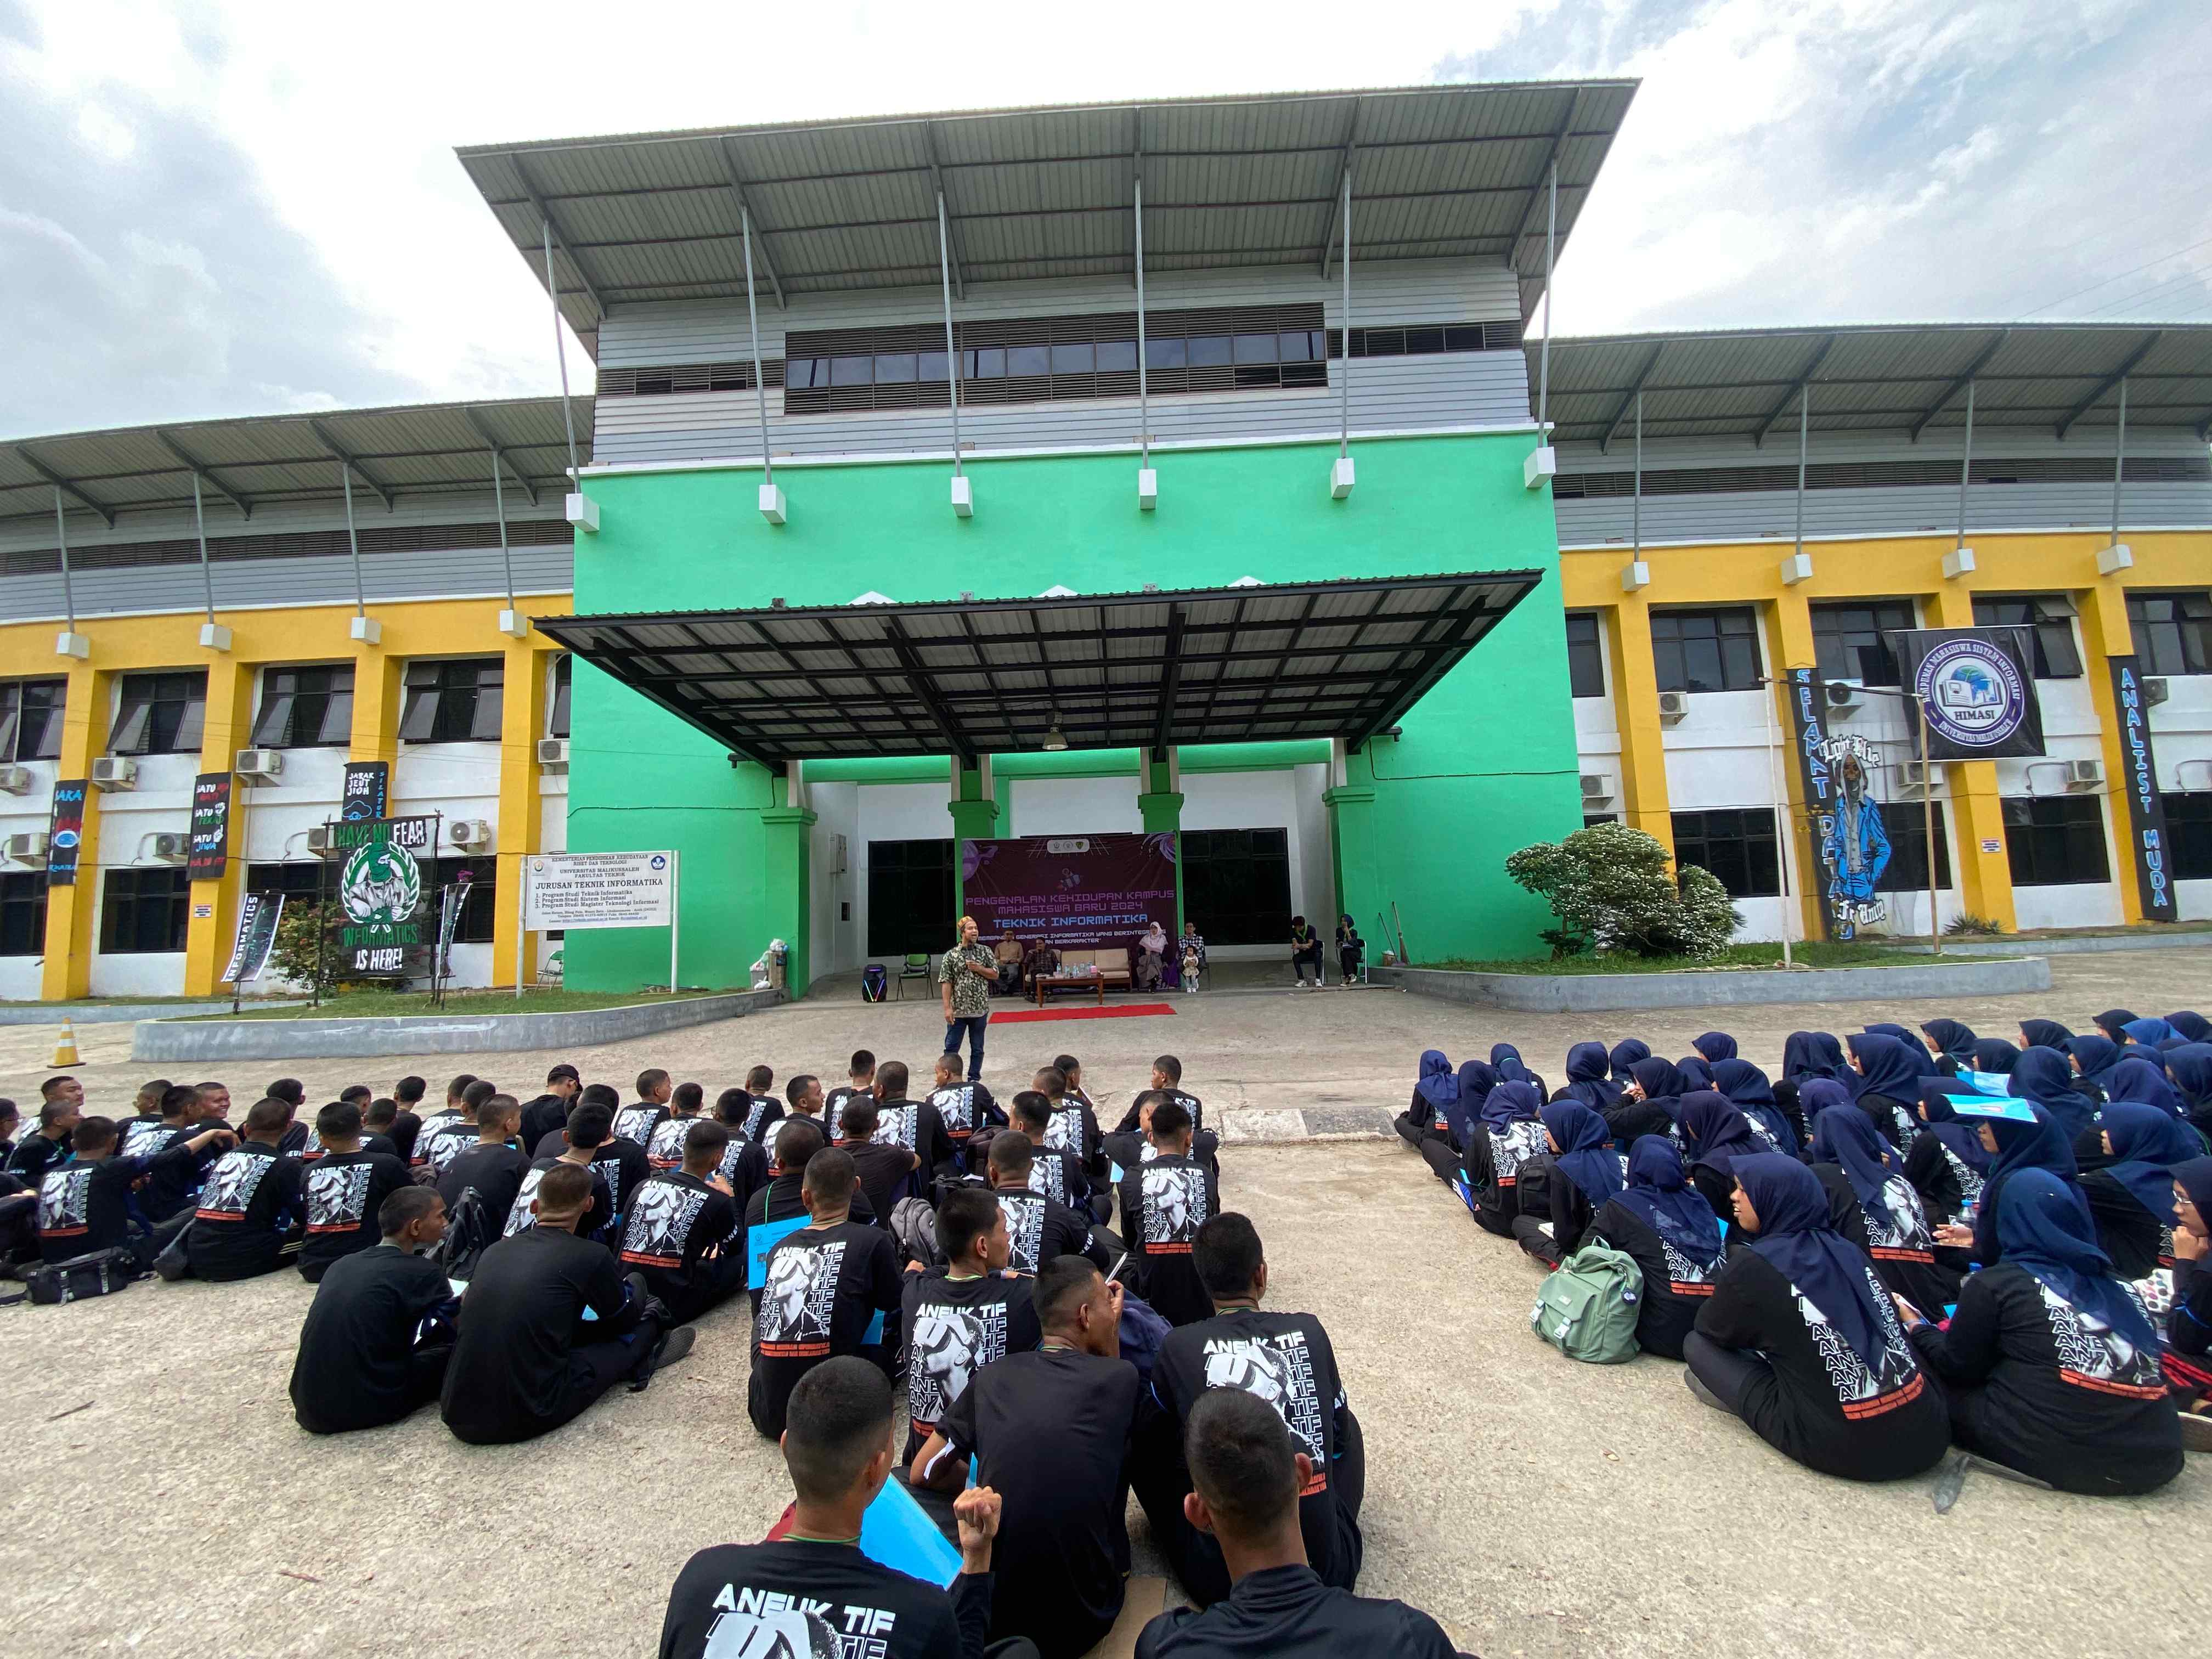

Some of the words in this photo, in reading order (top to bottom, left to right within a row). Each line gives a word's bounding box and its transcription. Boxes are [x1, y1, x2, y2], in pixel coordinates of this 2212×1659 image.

[1973, 644, 1999, 662] SISTEM
[1954, 710, 1995, 720] HIMASI
[2121, 668, 2152, 813] ANALIST
[196, 784, 216, 793] SATU
[195, 808, 213, 817] SATU
[193, 834, 212, 843] SATU
[393, 821, 425, 845] FEAR
[2142, 829, 2168, 907] MUDA
[607, 879, 663, 887] INFORMATIKA
[966, 895, 1046, 905] PENGENALAN
[1050, 892, 1122, 902] KEHIDUPAN
[1127, 890, 1175, 900] KAMPUS
[998, 904, 1070, 915] MAHASISWA
[1075, 902, 1107, 912] BARU
[1111, 901, 1143, 910] 2024
[993, 918, 1046, 928] TEKNIK
[1051, 913, 1148, 927] INFORMATIKA
[224, 896, 258, 982] INFORMATICS
[356, 949, 368, 970] IS
[370, 947, 403, 970] HERE!
[353, 1163, 373, 1172] TIF
[603, 1159, 620, 1167] TIF
[1142, 1167, 1182, 1178] ANEUK
[1186, 1168, 1204, 1177] TIF
[642, 1180, 686, 1192] ANEUK
[689, 1189, 709, 1200] TIF
[1189, 1203, 1206, 1212] TIF
[1189, 1212, 1206, 1222] TIF
[673, 1221, 691, 1232] TIF
[1019, 1233, 1041, 1243] TIF
[774, 1246, 819, 1259] ANEUK
[823, 1242, 847, 1254] TIF
[1018, 1243, 1040, 1254] TIF
[822, 1252, 843, 1265] TIF
[817, 1276, 838, 1289] TIF
[810, 1289, 835, 1302] TIF
[808, 1301, 833, 1314] TIF
[916, 1303, 974, 1318] ANEUK
[980, 1302, 1007, 1318] TIF
[981, 1317, 1007, 1332] TIF
[1203, 1337, 1269, 1355] ANEUK
[1274, 1331, 1305, 1350] TIF
[1283, 1346, 1309, 1363] TIF
[1289, 1397, 1319, 1416] TIF
[1291, 1414, 1322, 1434] TIF
[712, 1583, 833, 1617] ANEUK
[844, 1605, 896, 1636] TIF
